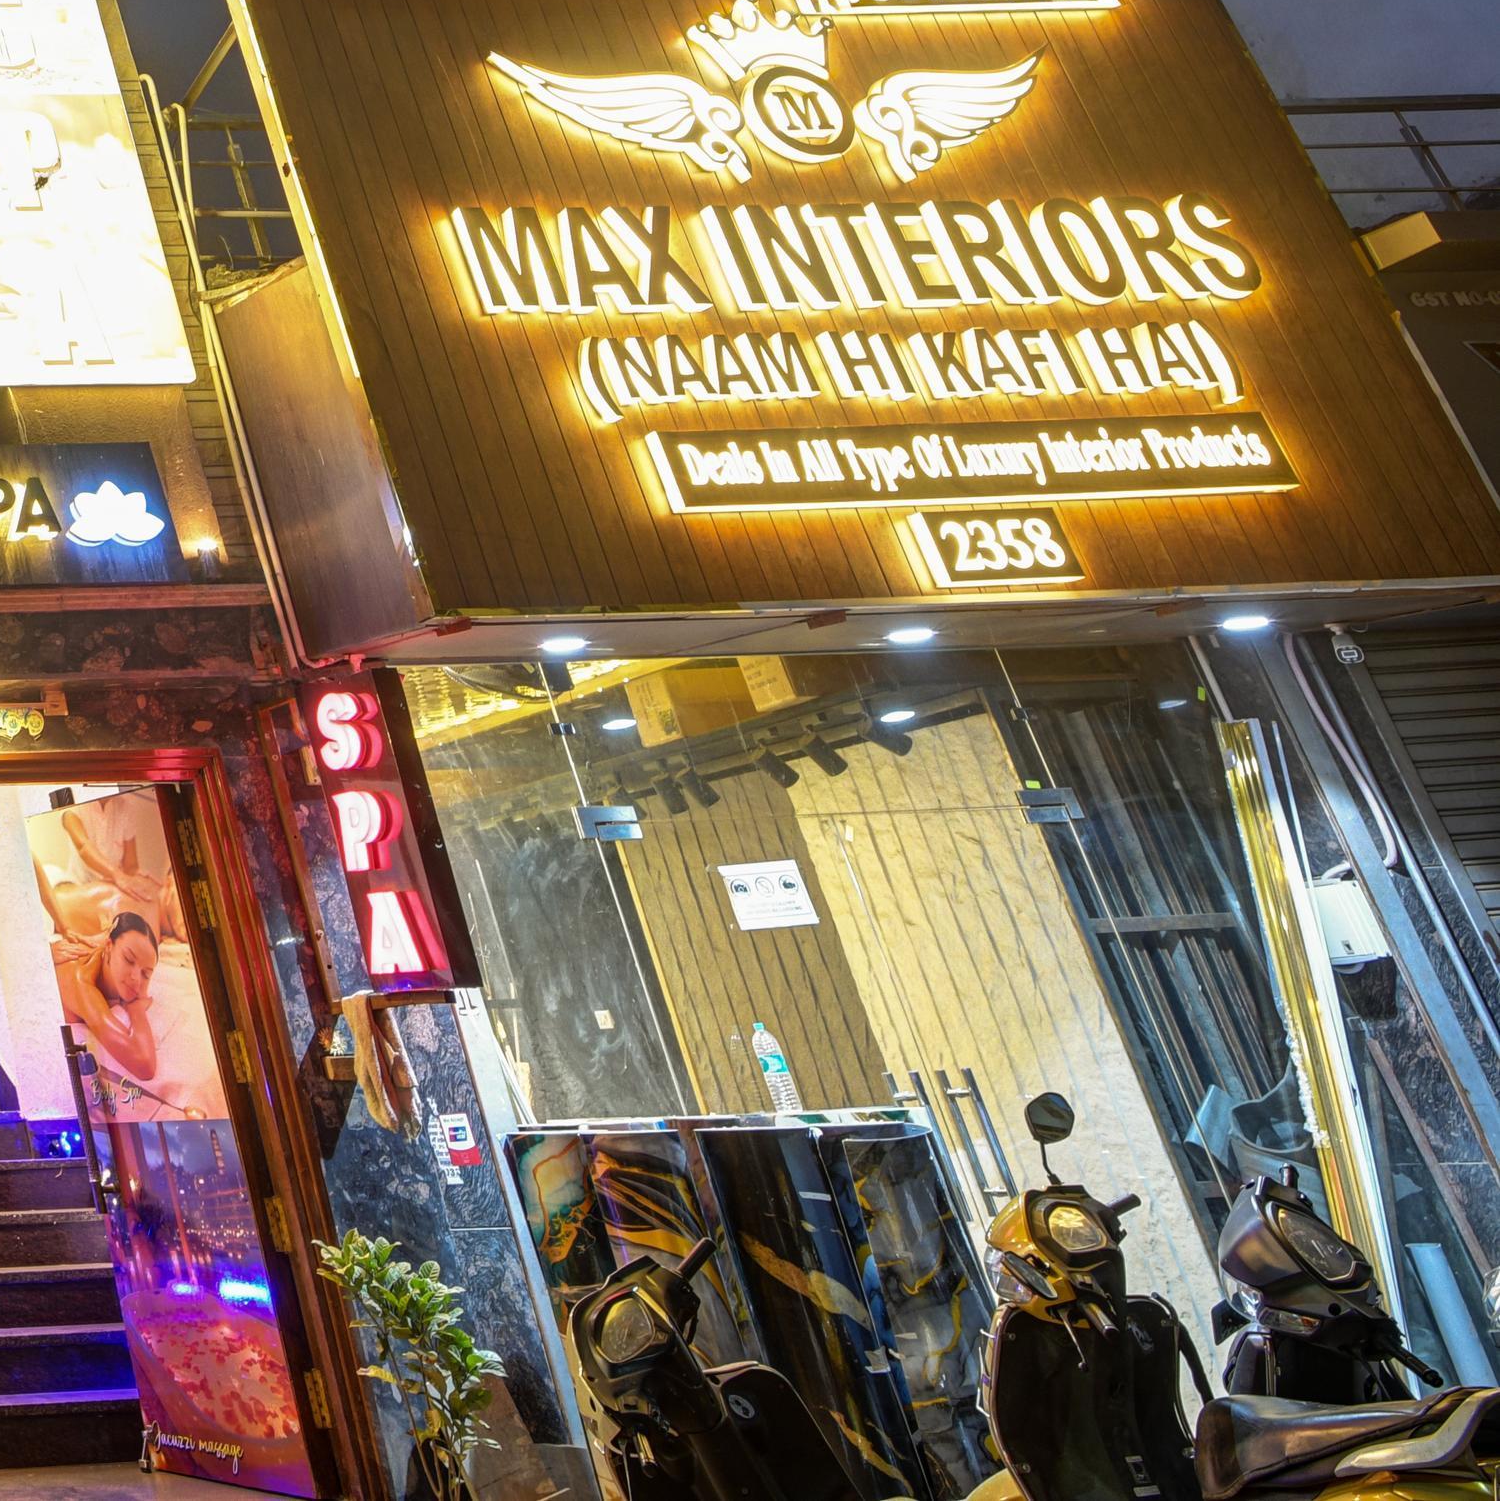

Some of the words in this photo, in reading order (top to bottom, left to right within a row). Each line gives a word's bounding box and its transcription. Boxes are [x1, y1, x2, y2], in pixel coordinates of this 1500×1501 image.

[453, 204, 712, 315] MAX
[700, 193, 1263, 311] INTERIORS
[578, 330, 821, 424] (NAAM
[816, 330, 916, 402] HI
[908, 327, 1087, 399] KAFI
[1075, 319, 1244, 405] HAI)
[679, 442, 763, 486] Deals
[798, 438, 835, 483] All
[839, 436, 915, 492] Type
[914, 433, 953, 479] Of
[948, 434, 1047, 486] Luxury
[1048, 430, 1146, 475] Interior
[1141, 426, 1271, 472] Products
[940, 517, 1066, 573] 2358
[316, 692, 448, 975] SPA
